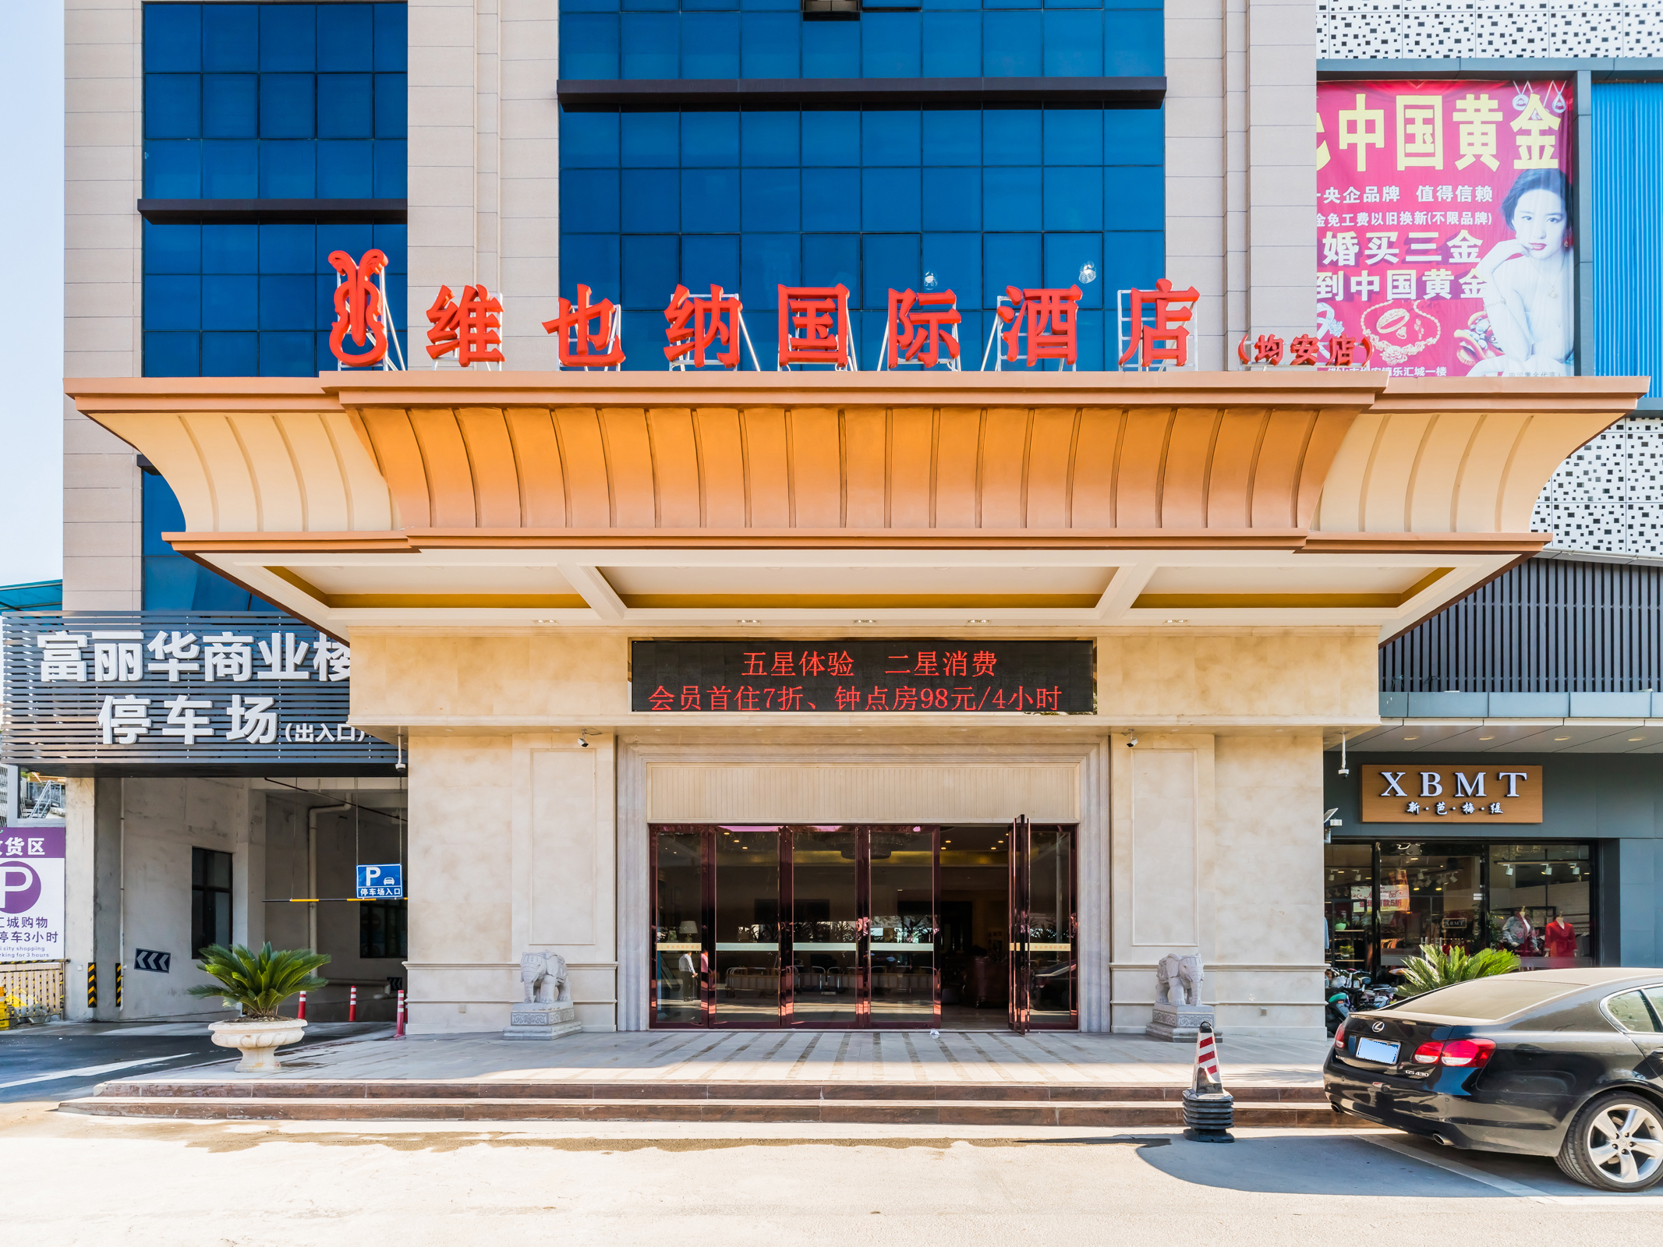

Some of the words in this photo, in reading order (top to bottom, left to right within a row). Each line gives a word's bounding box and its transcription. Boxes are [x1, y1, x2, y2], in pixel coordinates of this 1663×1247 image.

[1317, 185, 1400, 204] 央企品牌
[1416, 185, 1493, 202] 值得信赖
[1322, 229, 1483, 266] 婚买三金
[1317, 268, 1490, 301] 到中国黄金
[426, 278, 1200, 368] 维也纳国际酒店
[1238, 334, 1374, 367] (均安店)
[741, 650, 855, 677] 五星体验
[884, 650, 998, 677] 二星消费
[648, 685, 1063, 711] 会员首住7折、钟点房98元/4小时
[0, 837, 45, 856] 货区
[366, 866, 381, 886] P
[360, 888, 400, 896] 停车场入口
